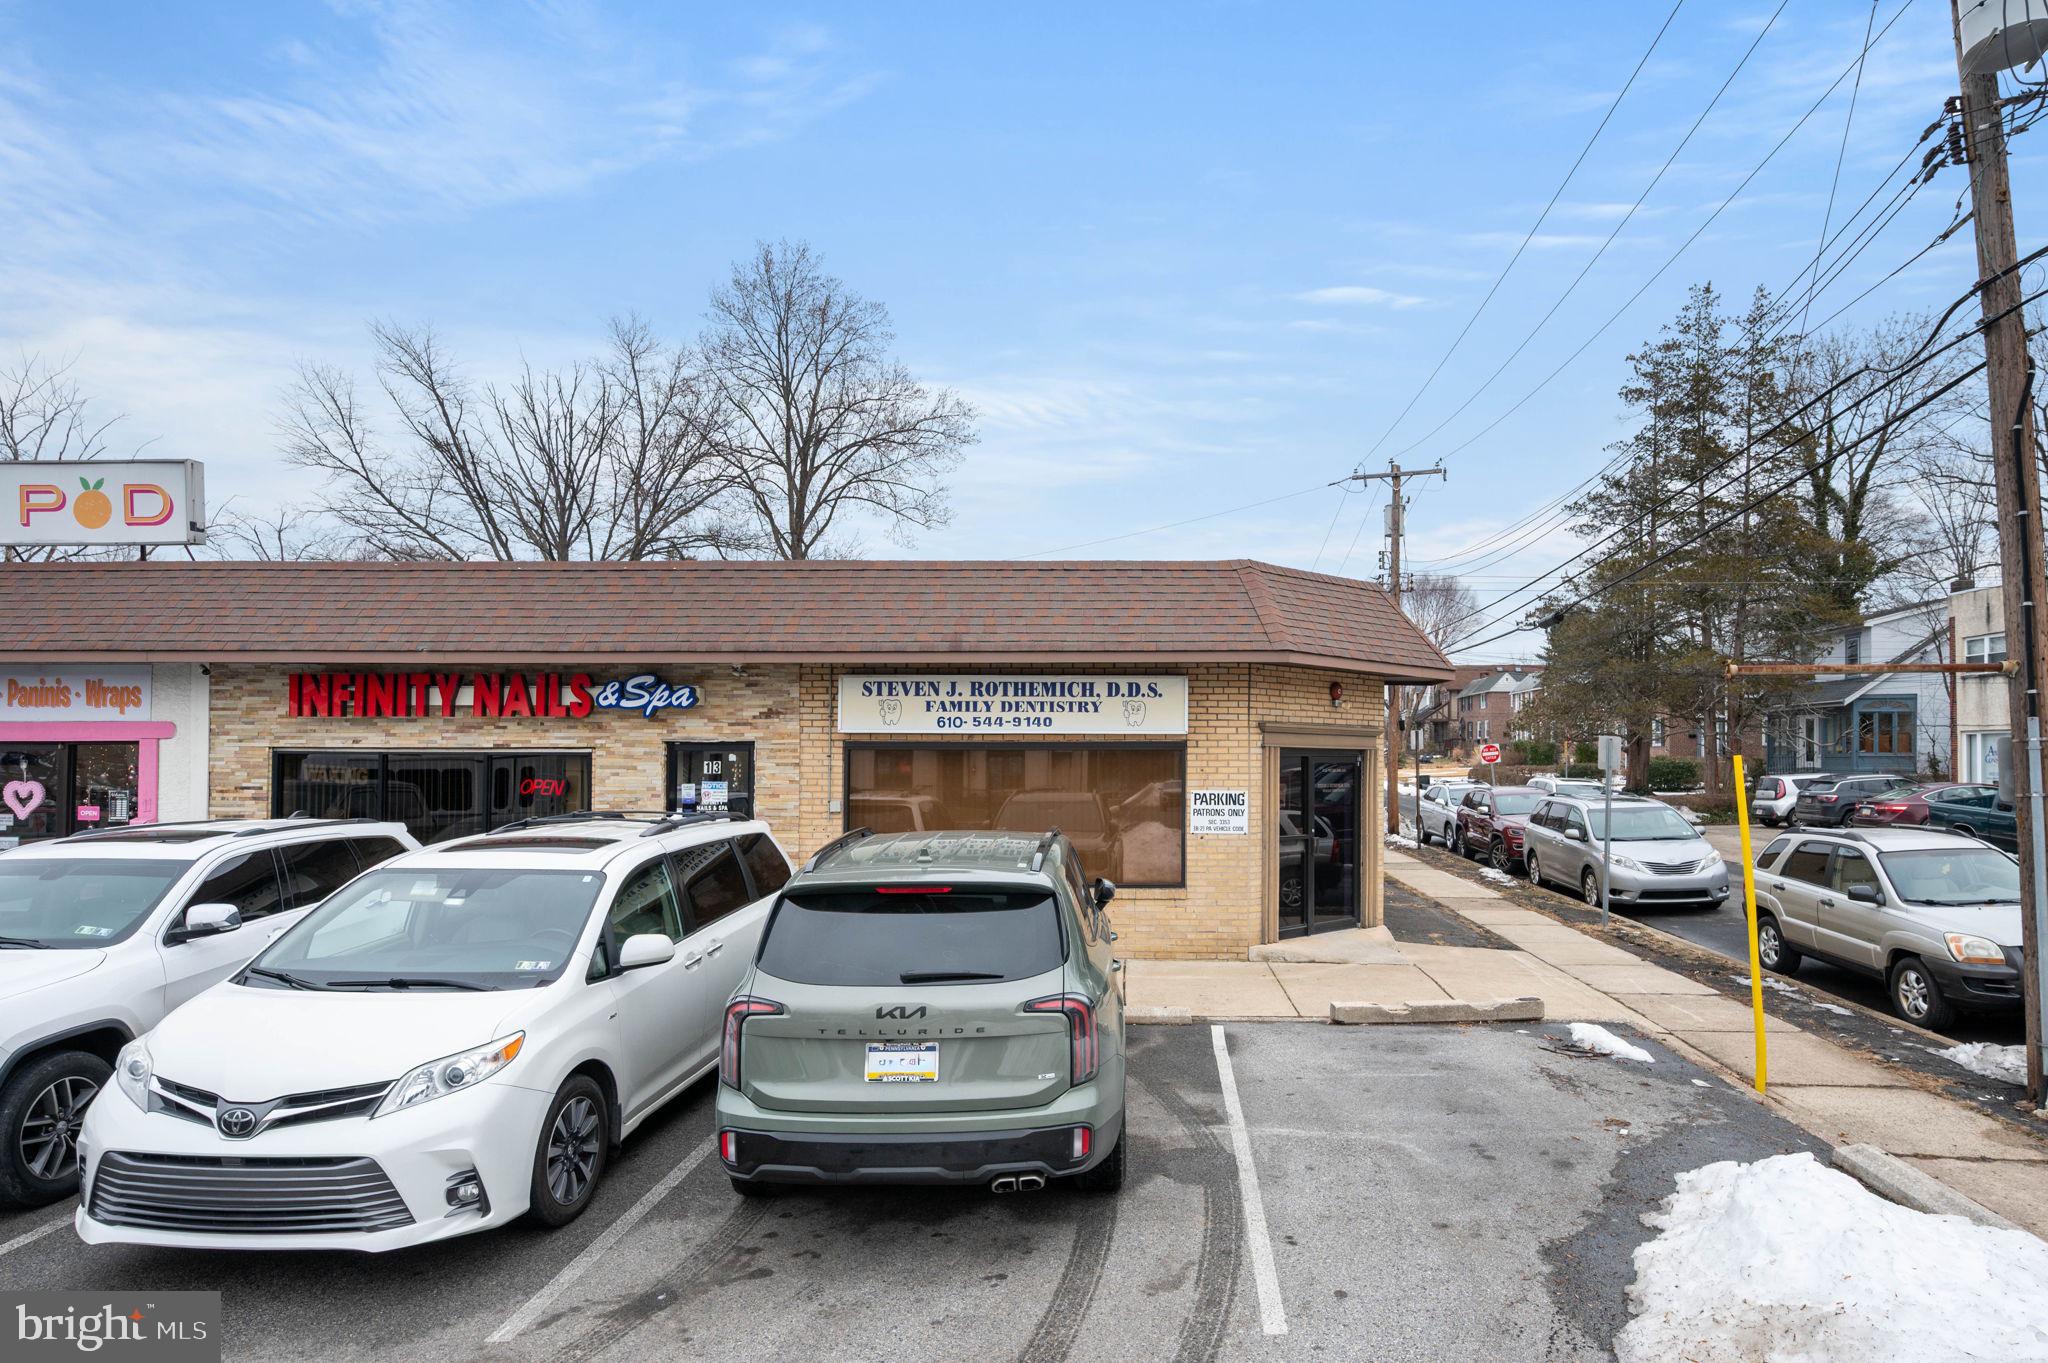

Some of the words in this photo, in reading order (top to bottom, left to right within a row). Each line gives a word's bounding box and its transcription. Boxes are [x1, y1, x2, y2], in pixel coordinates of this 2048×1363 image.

[7, 678, 72, 708] Paninis
[85, 678, 143, 715] Wraps
[288, 672, 460, 717] INFINITY
[473, 672, 592, 718] NAILS
[862, 681, 941, 697] STEVEN
[946, 681, 962, 697] J.
[970, 681, 1101, 699] ROTHEMICH,
[1106, 682, 1163, 698] D.D.S.
[925, 700, 995, 713] FAMILY
[1000, 700, 1102, 713] DENTISTRY
[705, 761, 720, 774] 13
[519, 778, 565, 796] OPEN
[1193, 793, 1245, 806] PARKING
[876, 1006, 926, 1019] KIA
[818, 1027, 985, 1036] TELLURIDE
